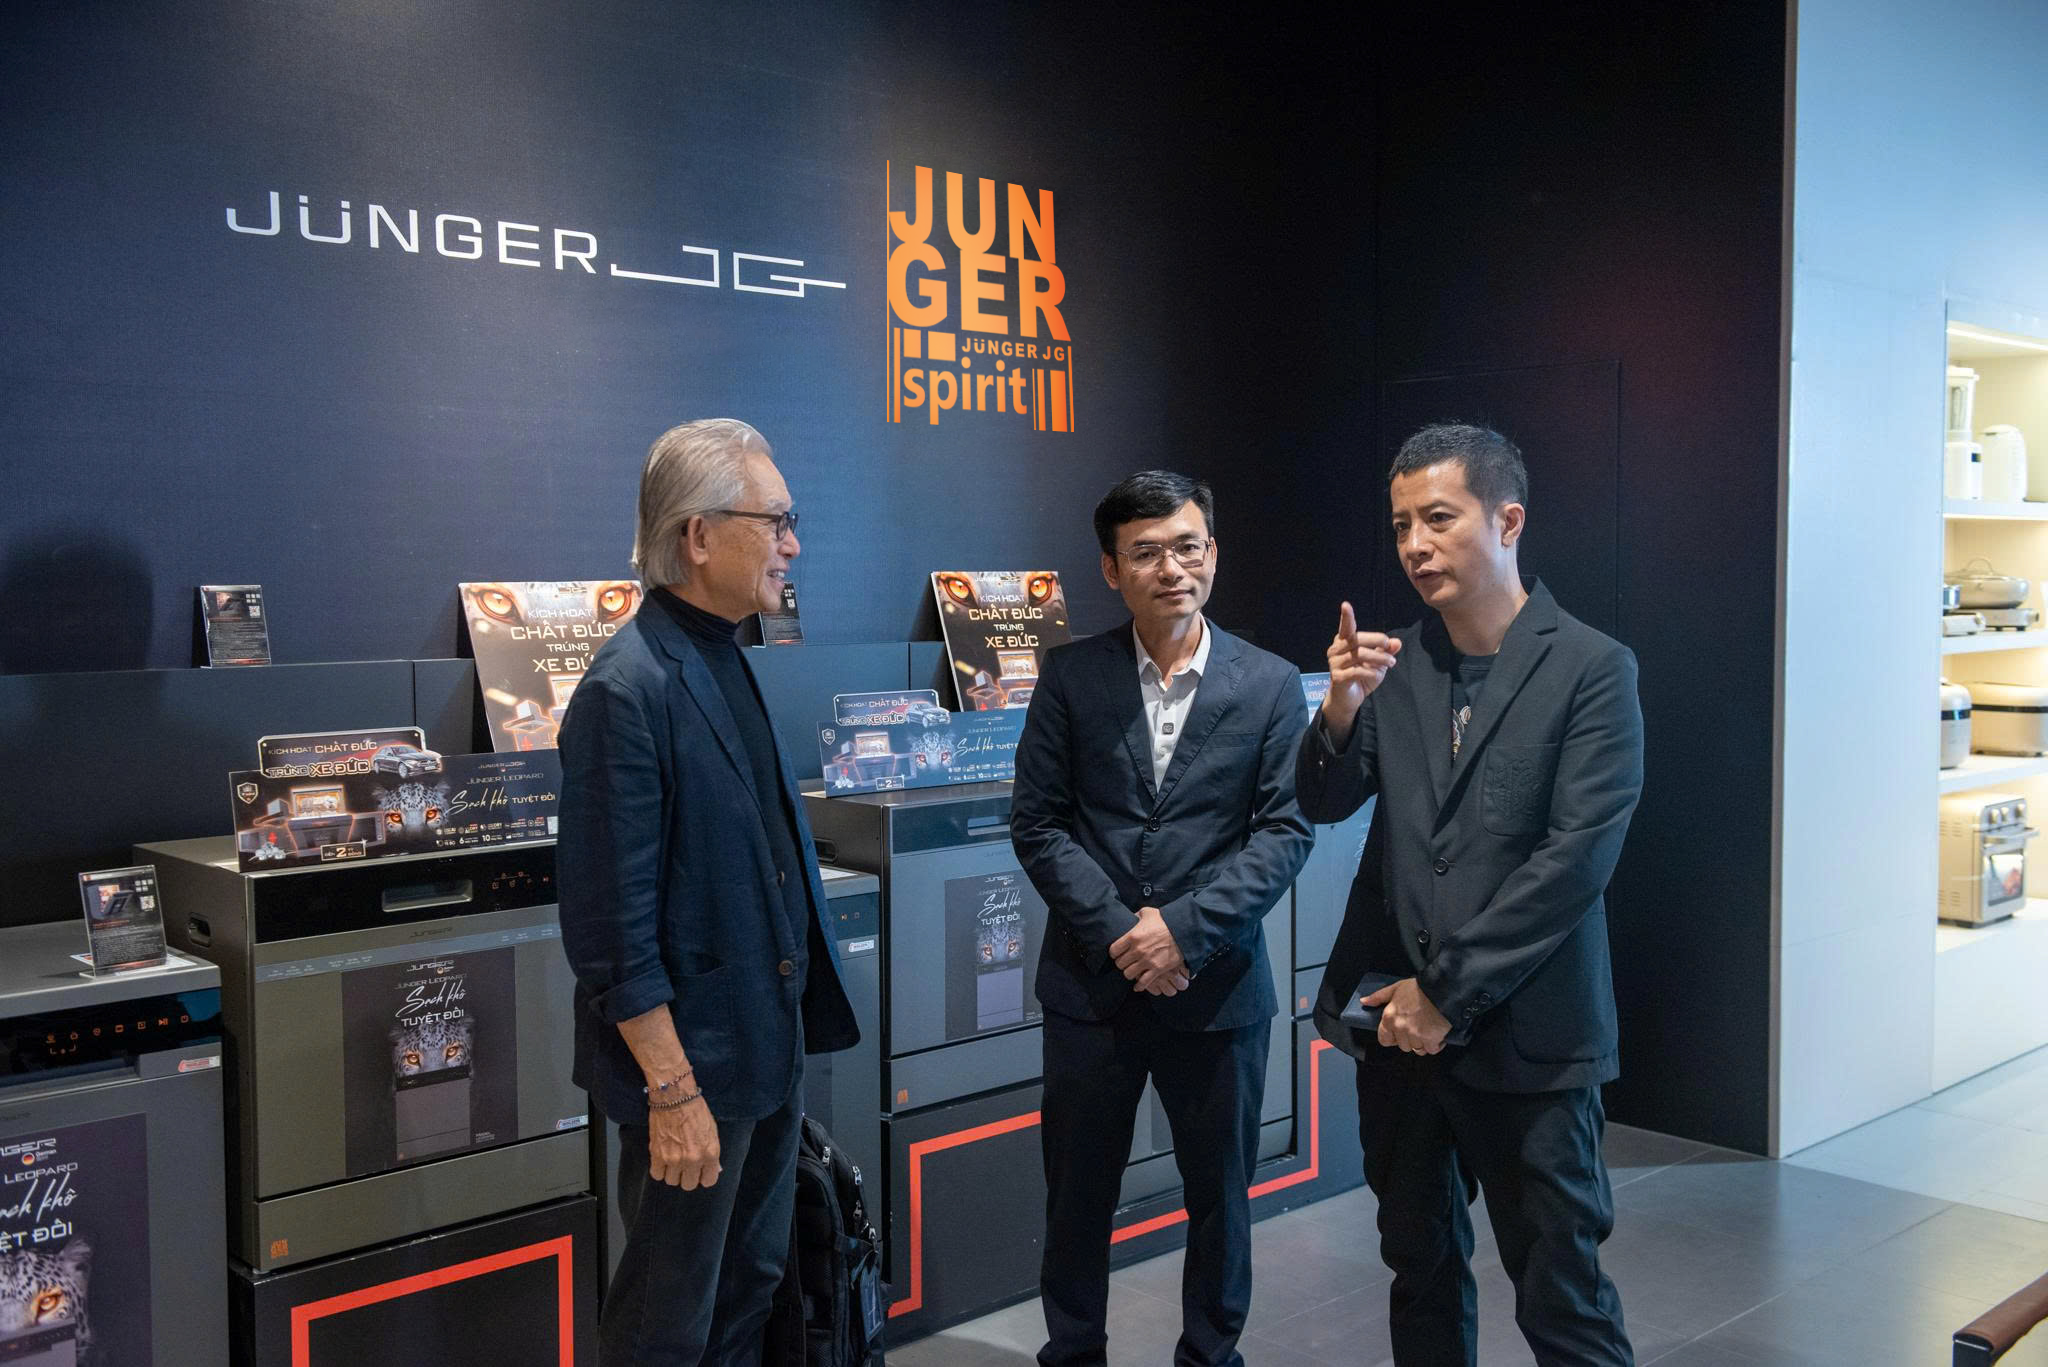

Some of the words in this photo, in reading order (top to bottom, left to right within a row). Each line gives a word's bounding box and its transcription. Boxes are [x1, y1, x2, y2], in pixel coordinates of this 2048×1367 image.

[888, 165, 1057, 264] JUN
[888, 242, 1072, 342] GER
[1043, 345, 1065, 362] JG
[903, 356, 1028, 426] spirit
[1011, 604, 1044, 620] ĐỨC
[993, 622, 1025, 632] TRÚNG
[545, 641, 590, 653] TRÚNG
[985, 635, 1005, 649] XE
[1006, 632, 1039, 648] ĐỨC
[533, 657, 562, 673] XE
[309, 763, 333, 777] XE
[335, 757, 370, 775] ĐỨC
[885, 779, 892, 788] 2
[482, 834, 491, 842] 10
[336, 847, 347, 858] 2
[401, 1011, 442, 1027] TUYỆT
[0, 1138, 56, 1157] GER
[4, 1162, 79, 1184] LEOPARD
[36, 1172, 79, 1223] khô
[32, 1218, 73, 1243] ĐỐI
